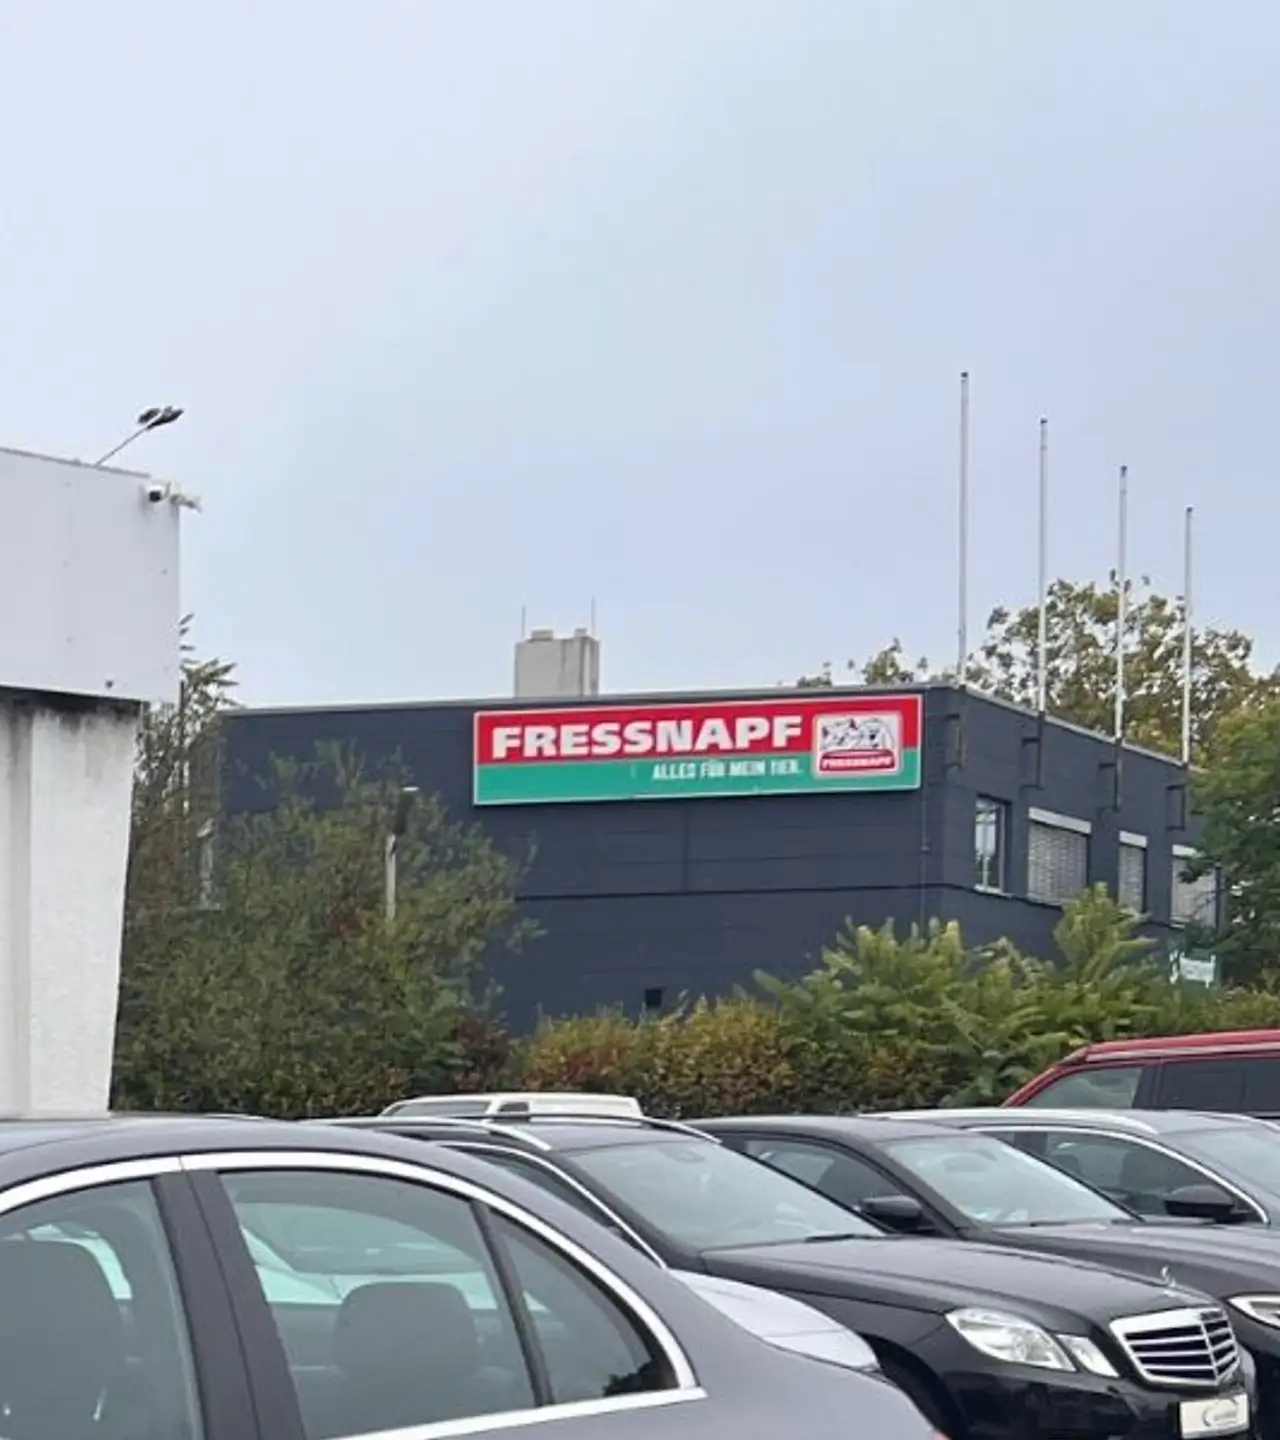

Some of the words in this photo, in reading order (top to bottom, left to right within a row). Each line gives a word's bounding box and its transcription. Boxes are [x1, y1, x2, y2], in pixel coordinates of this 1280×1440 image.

[491, 714, 802, 759] FRESSNAPF
[652, 762, 696, 781] ALLES
[700, 758, 725, 779] FÜR
[728, 759, 766, 777] MEIN
